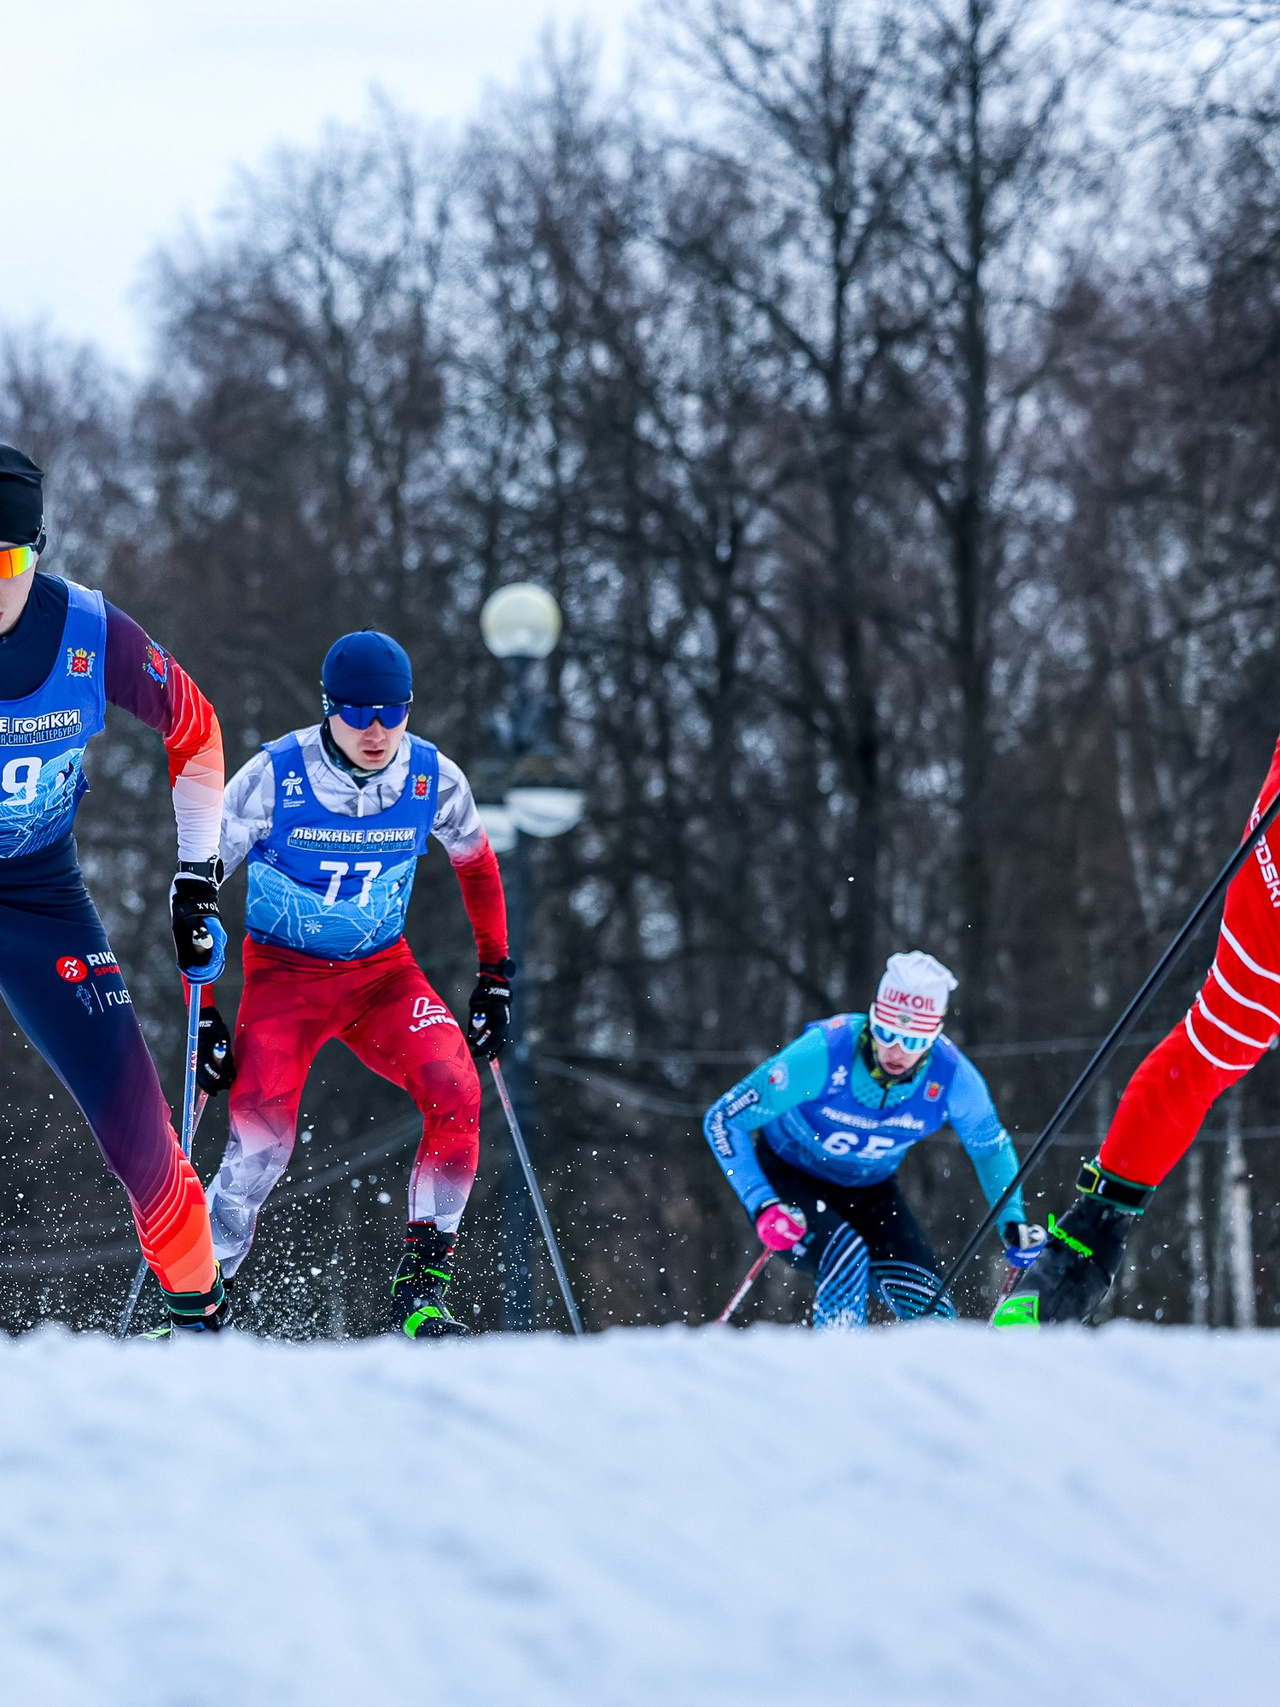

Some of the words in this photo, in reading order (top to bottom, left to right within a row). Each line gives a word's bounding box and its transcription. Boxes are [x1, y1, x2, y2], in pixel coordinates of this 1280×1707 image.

[14, 711, 79, 733] ГОНКИ
[8, 724, 81, 744] САНКТ-ПЕТЕРБУРГА
[293, 827, 363, 843] ЛЫЖНЫЕ
[367, 829, 414, 842] ГОНКИ
[319, 860, 382, 908] 77
[105, 989, 132, 1007] rus
[883, 987, 937, 1012] LUKOIL
